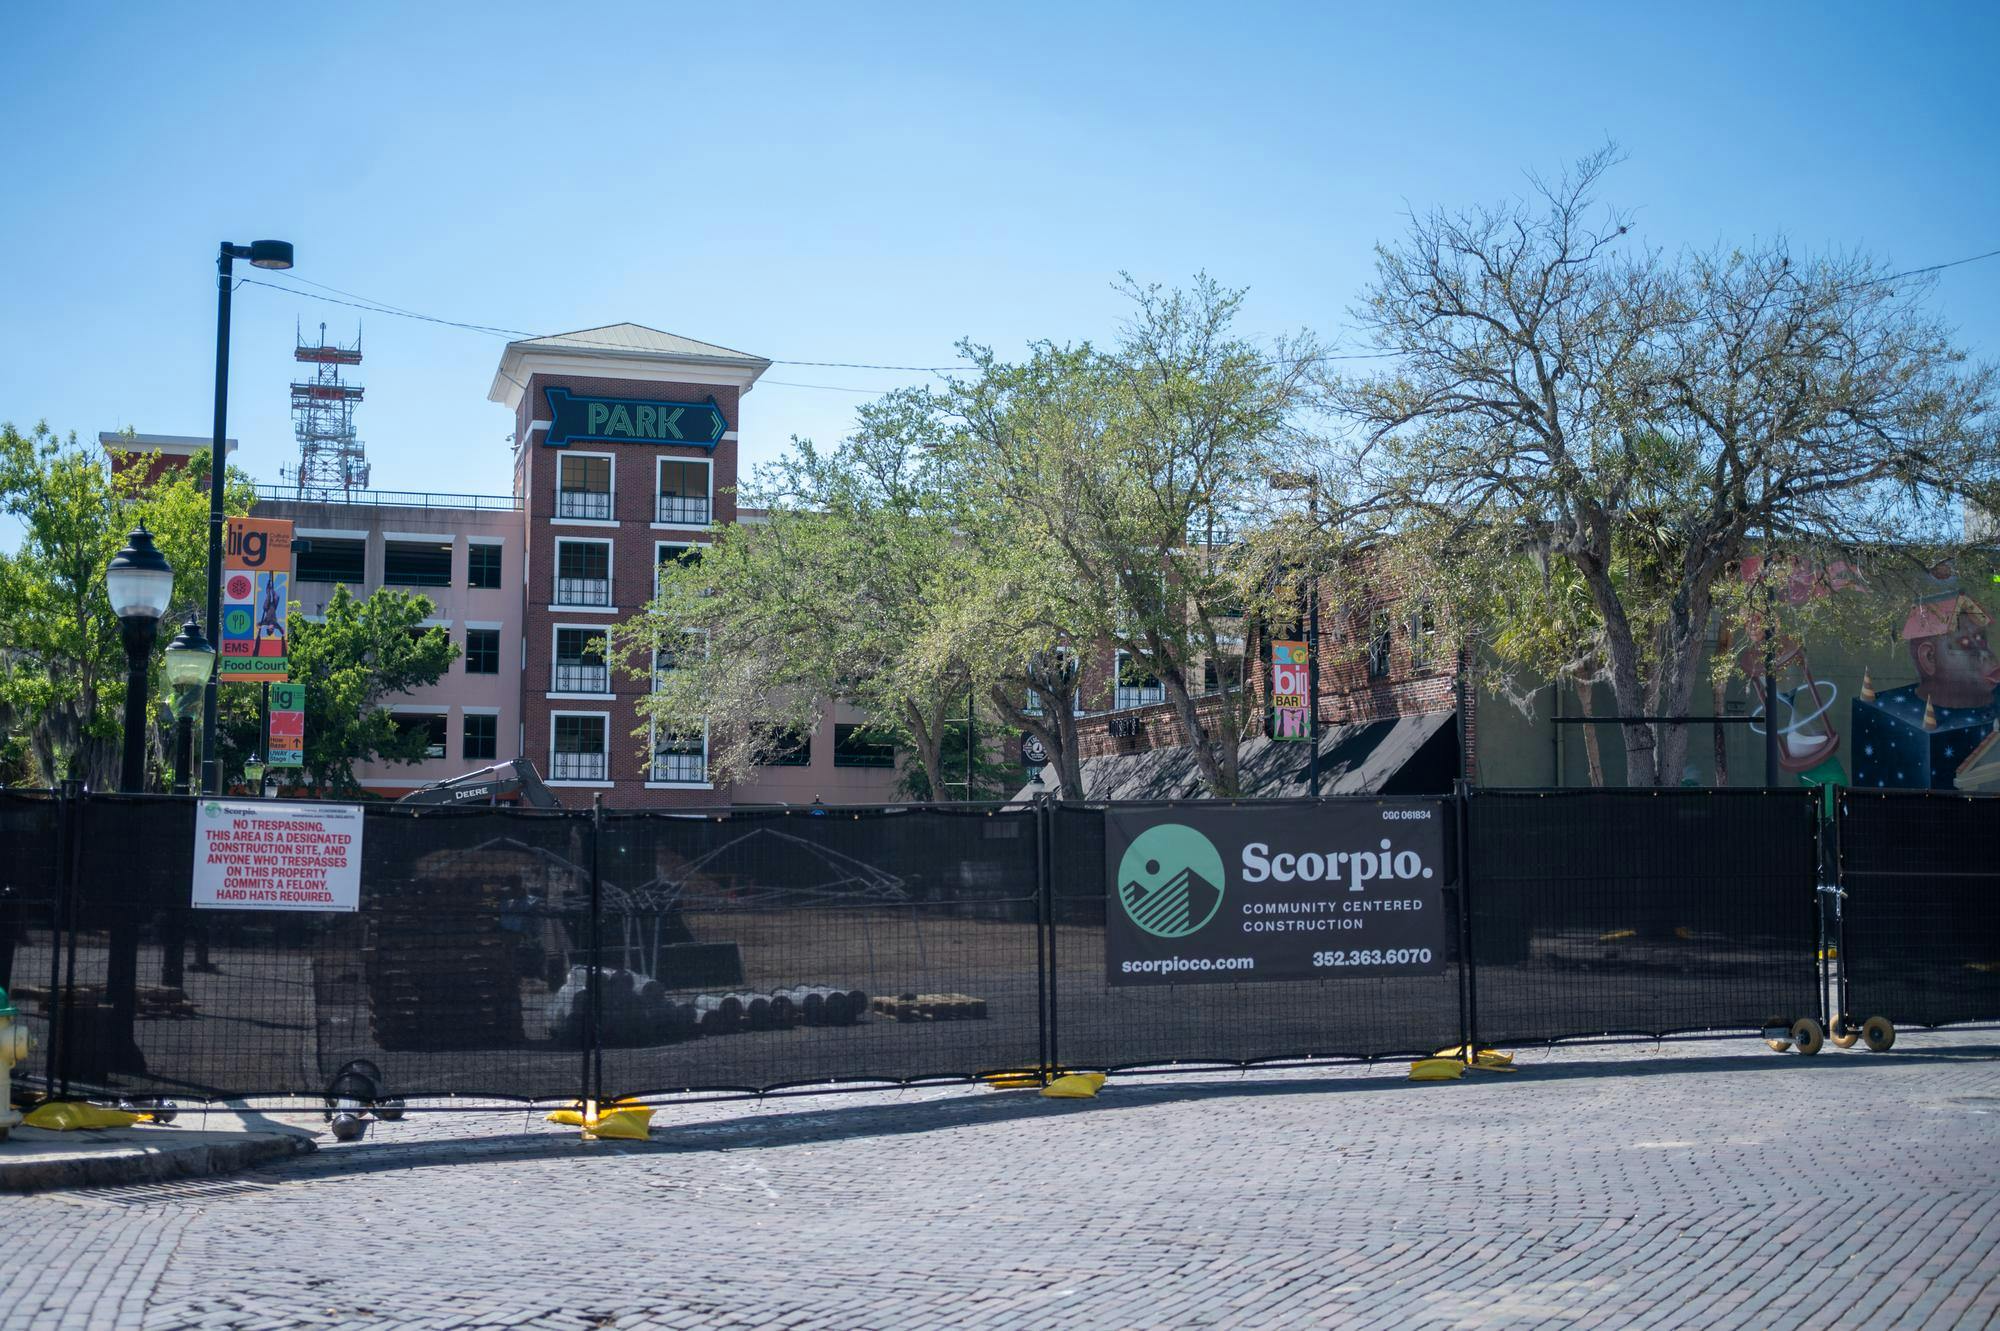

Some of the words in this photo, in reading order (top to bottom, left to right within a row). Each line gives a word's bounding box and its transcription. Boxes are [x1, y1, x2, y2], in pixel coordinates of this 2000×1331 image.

[588, 402, 685, 440] PARK
[228, 524, 268, 567] big
[225, 642, 249, 654] EMS
[224, 660, 252, 671] Food
[255, 660, 287, 671] Court
[1274, 664, 1308, 706] big
[1276, 696, 1298, 706] BAR
[456, 787, 488, 800] DEERE
[1382, 810, 1400, 820] CGC
[1401, 810, 1431, 820] 061834
[233, 819, 248, 830] NO
[252, 820, 326, 832] TRESPASSING.
[206, 830, 231, 841] THIS
[233, 832, 262, 842] AREA
[264, 832, 274, 842] IS
[276, 833, 283, 842] A
[286, 833, 352, 844] DESIGNATED
[210, 842, 293, 855] CONSTRUCTION
[296, 845, 321, 856] SITE,
[324, 846, 346, 856] AND
[207, 854, 250, 865] ANYONE
[254, 856, 278, 866] WHO
[282, 856, 348, 868] TRESPASSES
[1242, 838, 1433, 892] Scorpio.
[226, 866, 242, 876] ON
[244, 867, 269, 877] THIS
[271, 868, 327, 879] PROPERTY
[224, 878, 274, 889] COMMITS
[276, 880, 284, 889] A
[286, 880, 328, 891] FELONY.
[216, 890, 247, 900] HARD
[250, 890, 278, 901] HATS
[280, 891, 334, 903] REQUIRED.
[1242, 902, 1336, 915] COMMUNITY
[1342, 900, 1423, 912] CENTERED
[1243, 918, 1364, 932] CONSTRUCTION
[1122, 955, 1254, 974] scorpioco.com
[1312, 948, 1432, 968] 352.363.6070
